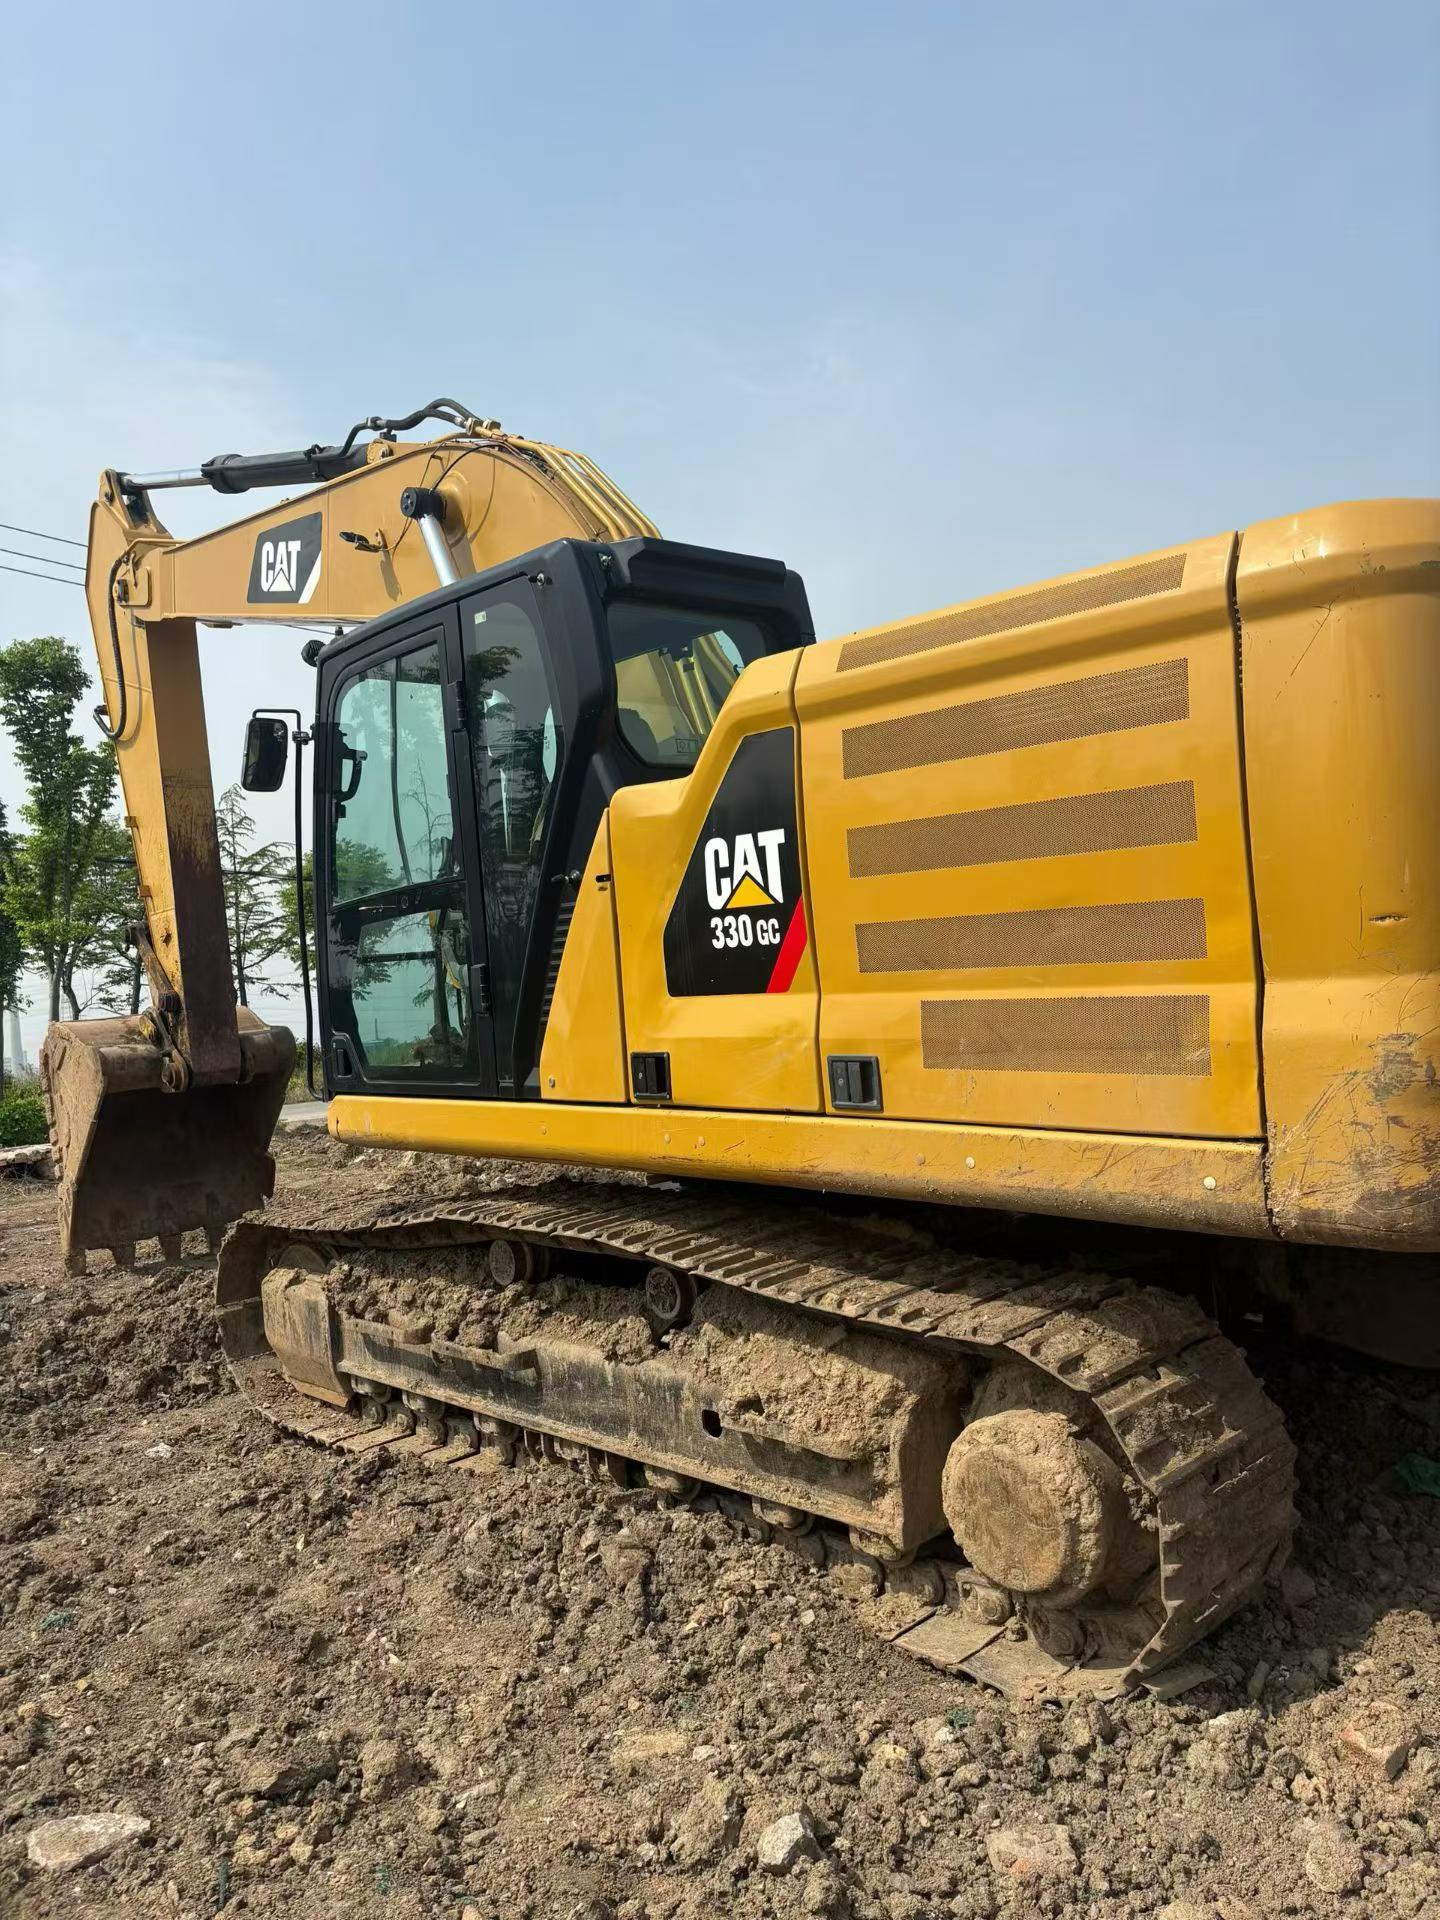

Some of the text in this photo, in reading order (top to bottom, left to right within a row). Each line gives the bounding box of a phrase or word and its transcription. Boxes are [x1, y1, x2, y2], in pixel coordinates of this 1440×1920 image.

[261, 540, 301, 592] CAT
[704, 828, 785, 910] CAT
[710, 914, 780, 949] 330 GC
